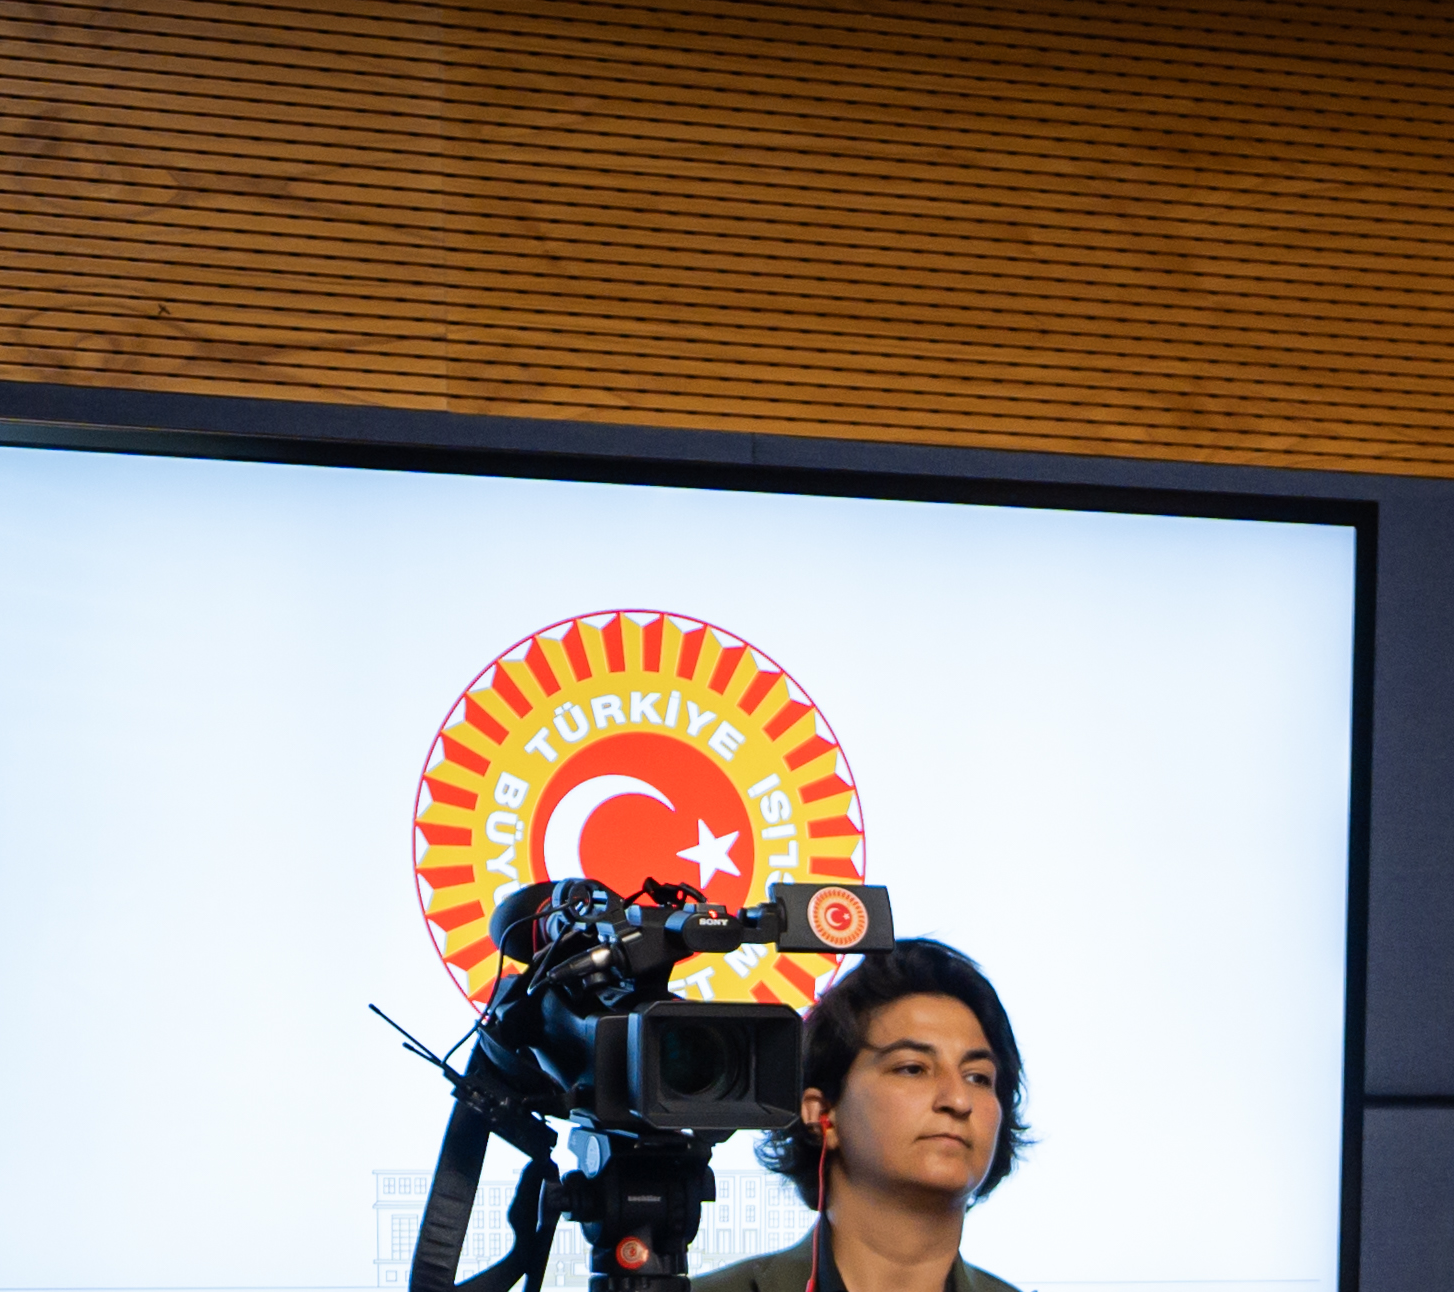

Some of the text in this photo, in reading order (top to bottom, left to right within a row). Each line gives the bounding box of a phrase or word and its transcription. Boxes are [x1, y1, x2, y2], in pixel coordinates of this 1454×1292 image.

[524, 690, 746, 762] TÜRKİYE
[485, 771, 531, 906] BÜYÜ
[699, 918, 728, 926] SONY
